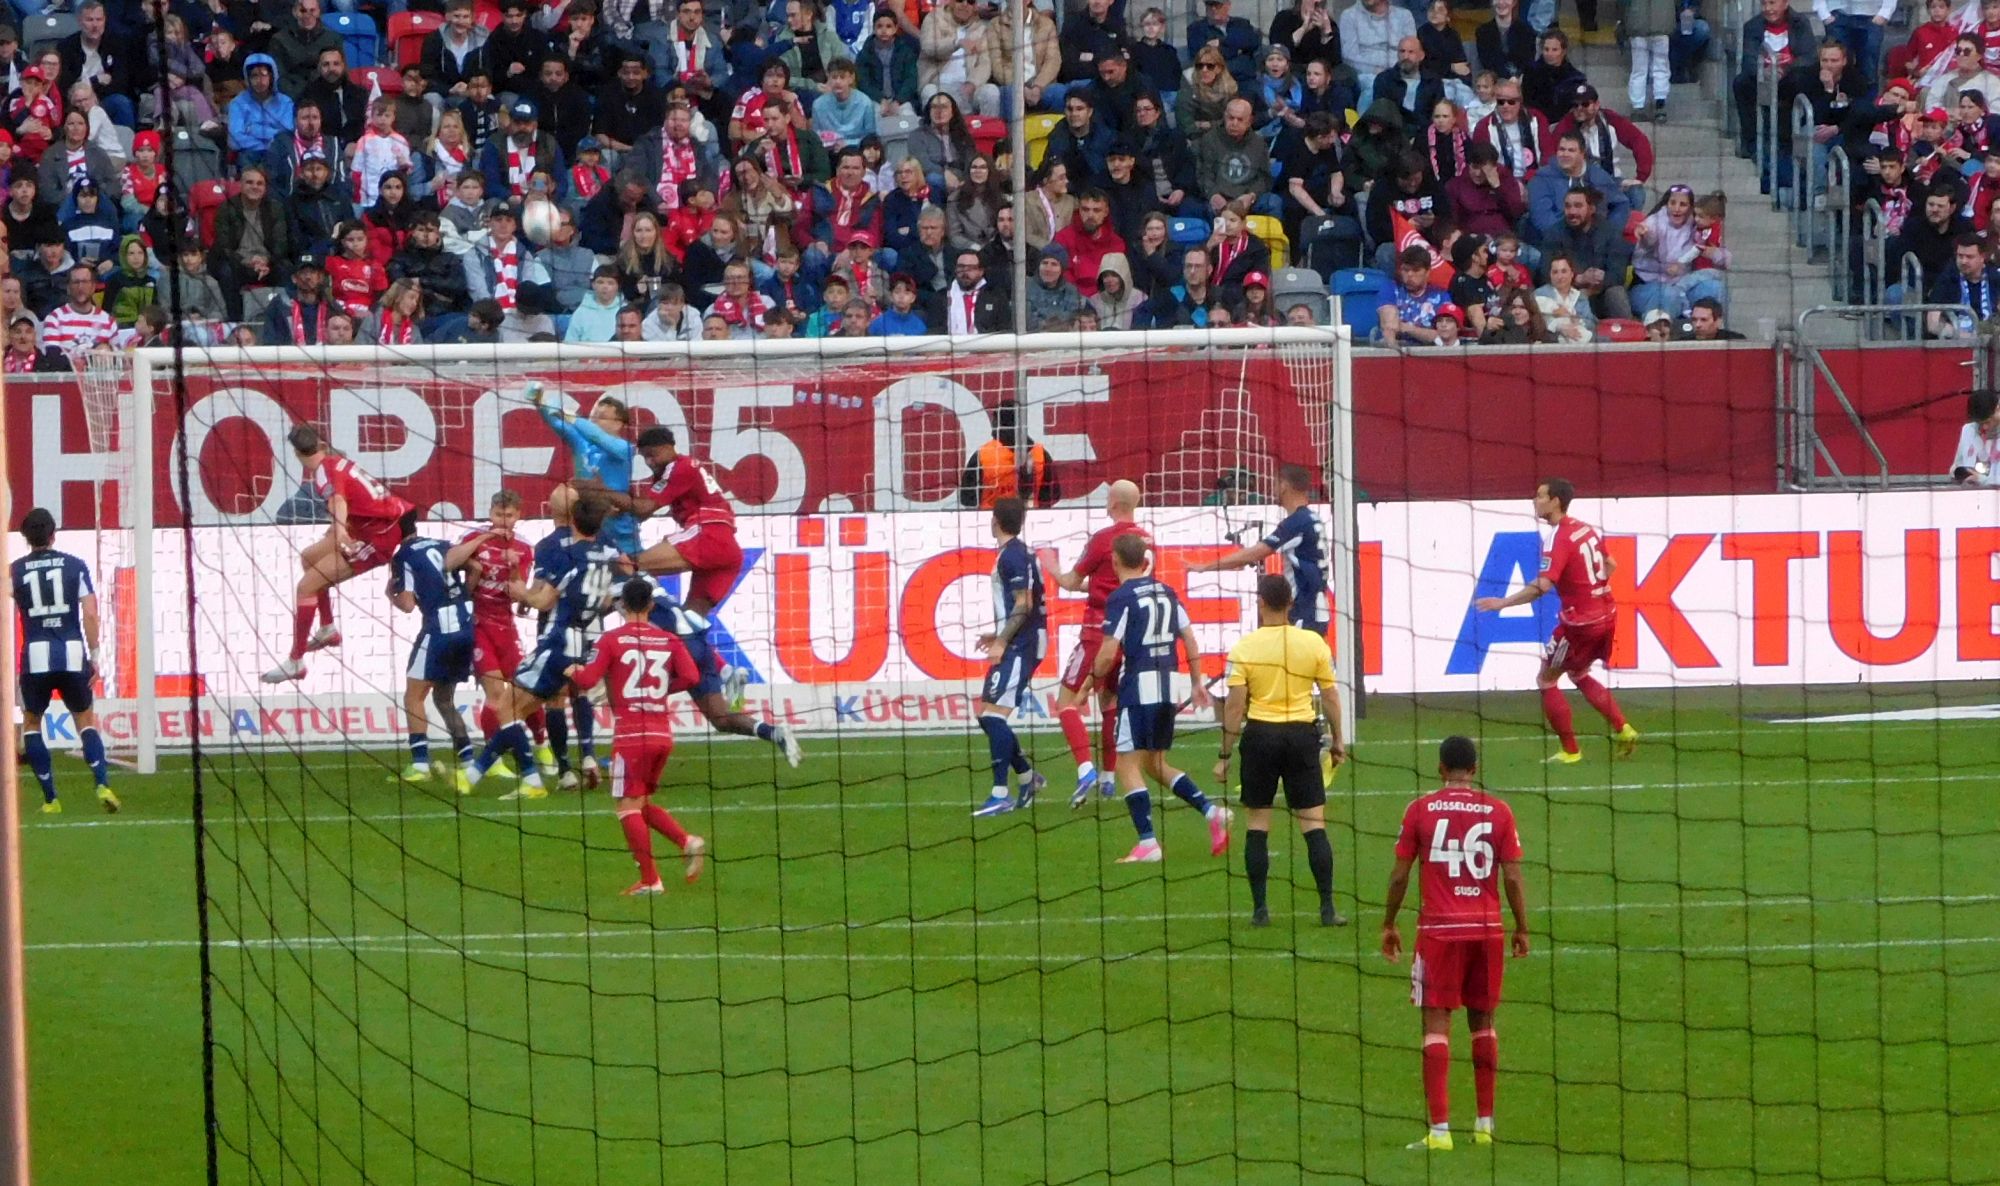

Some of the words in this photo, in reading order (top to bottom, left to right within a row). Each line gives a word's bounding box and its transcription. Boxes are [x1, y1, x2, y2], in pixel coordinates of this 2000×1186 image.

[1580, 536, 1608, 586] 15
[23, 568, 70, 617] 11
[1137, 596, 1174, 646] 22
[620, 649, 672, 699] 23
[990, 671, 1001, 690] 9
[44, 710, 213, 740] KCEN
[230, 706, 410, 736] AKTUELL
[1429, 818, 1494, 880] 46
[1454, 886, 1481, 897] SUSO
